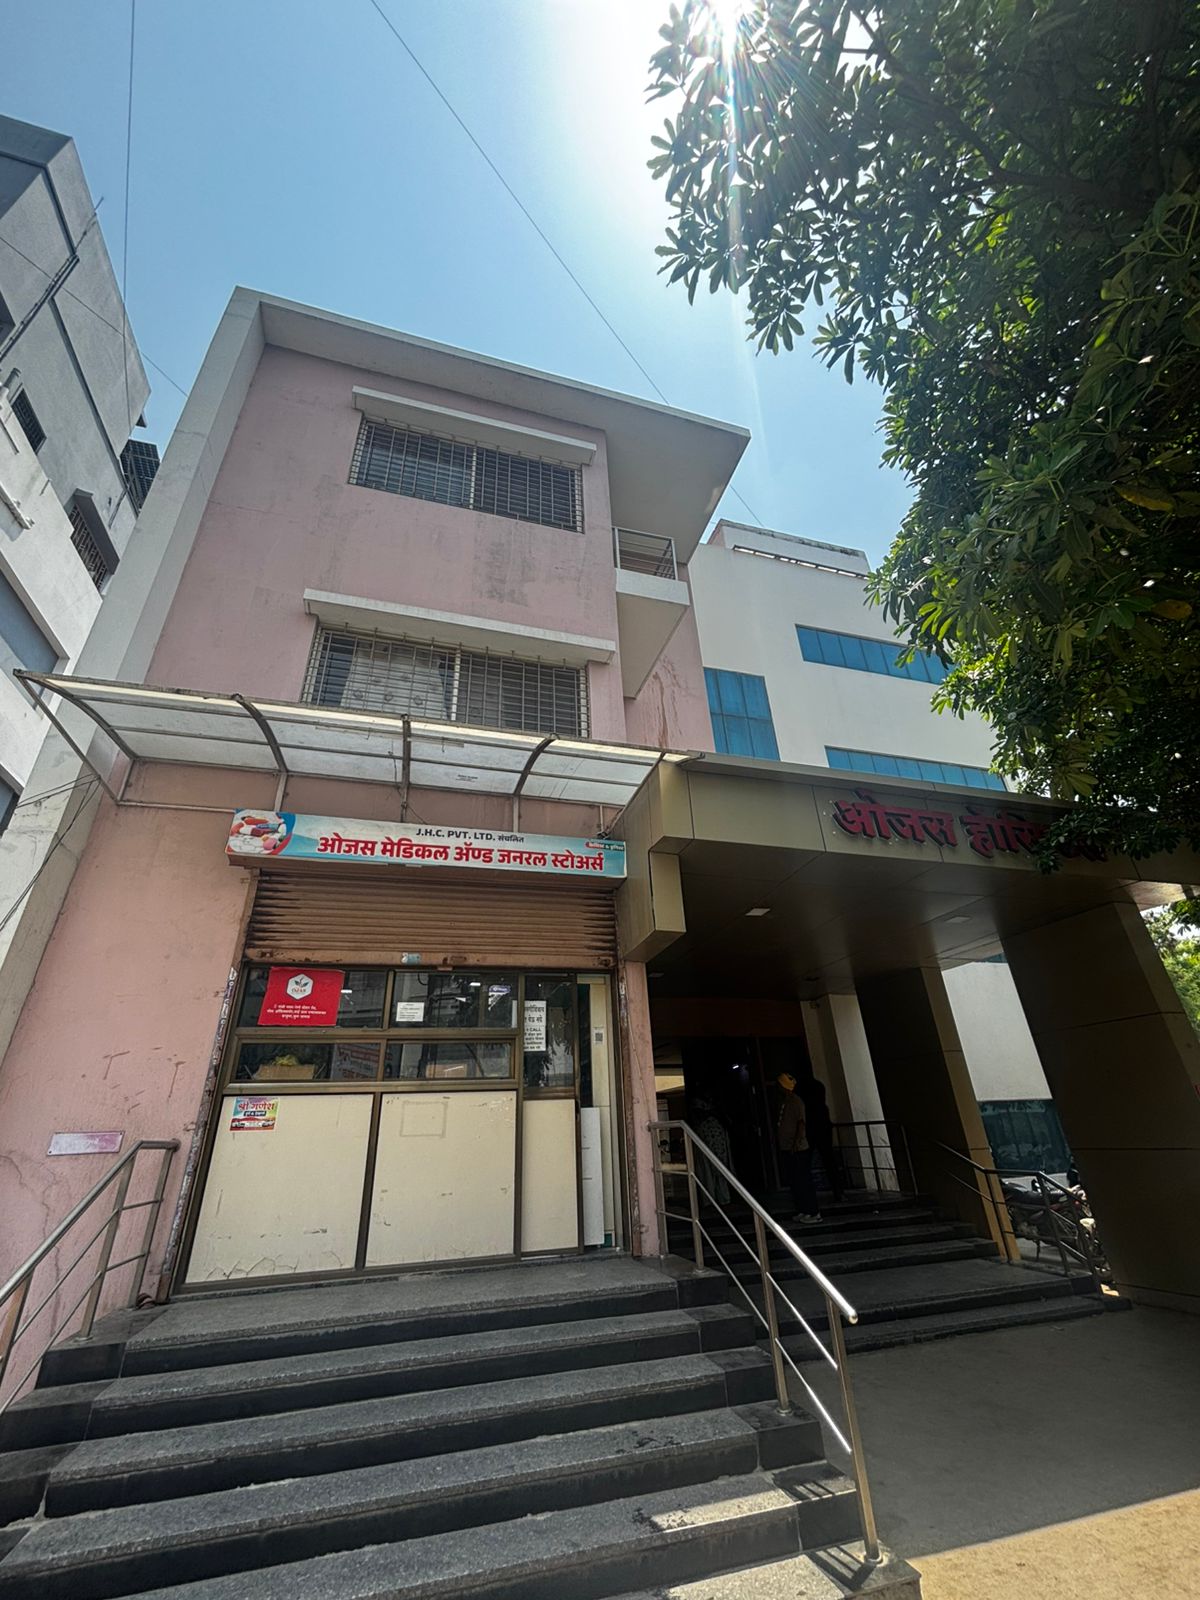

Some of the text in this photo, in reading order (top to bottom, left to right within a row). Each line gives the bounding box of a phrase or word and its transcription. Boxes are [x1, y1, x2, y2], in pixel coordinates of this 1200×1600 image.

[832, 788, 957, 847] ओजस
[416, 828, 445, 838] J.H.C.
[447, 830, 471, 840] PVT.
[473, 832, 495, 841] LTD.
[317, 832, 377, 856] ओजस
[381, 836, 450, 861] मेडिकल
[497, 848, 547, 867] जनरल
[551, 850, 604, 871] स्टोअर्स
[250, 1100, 275, 1110] गणेश
